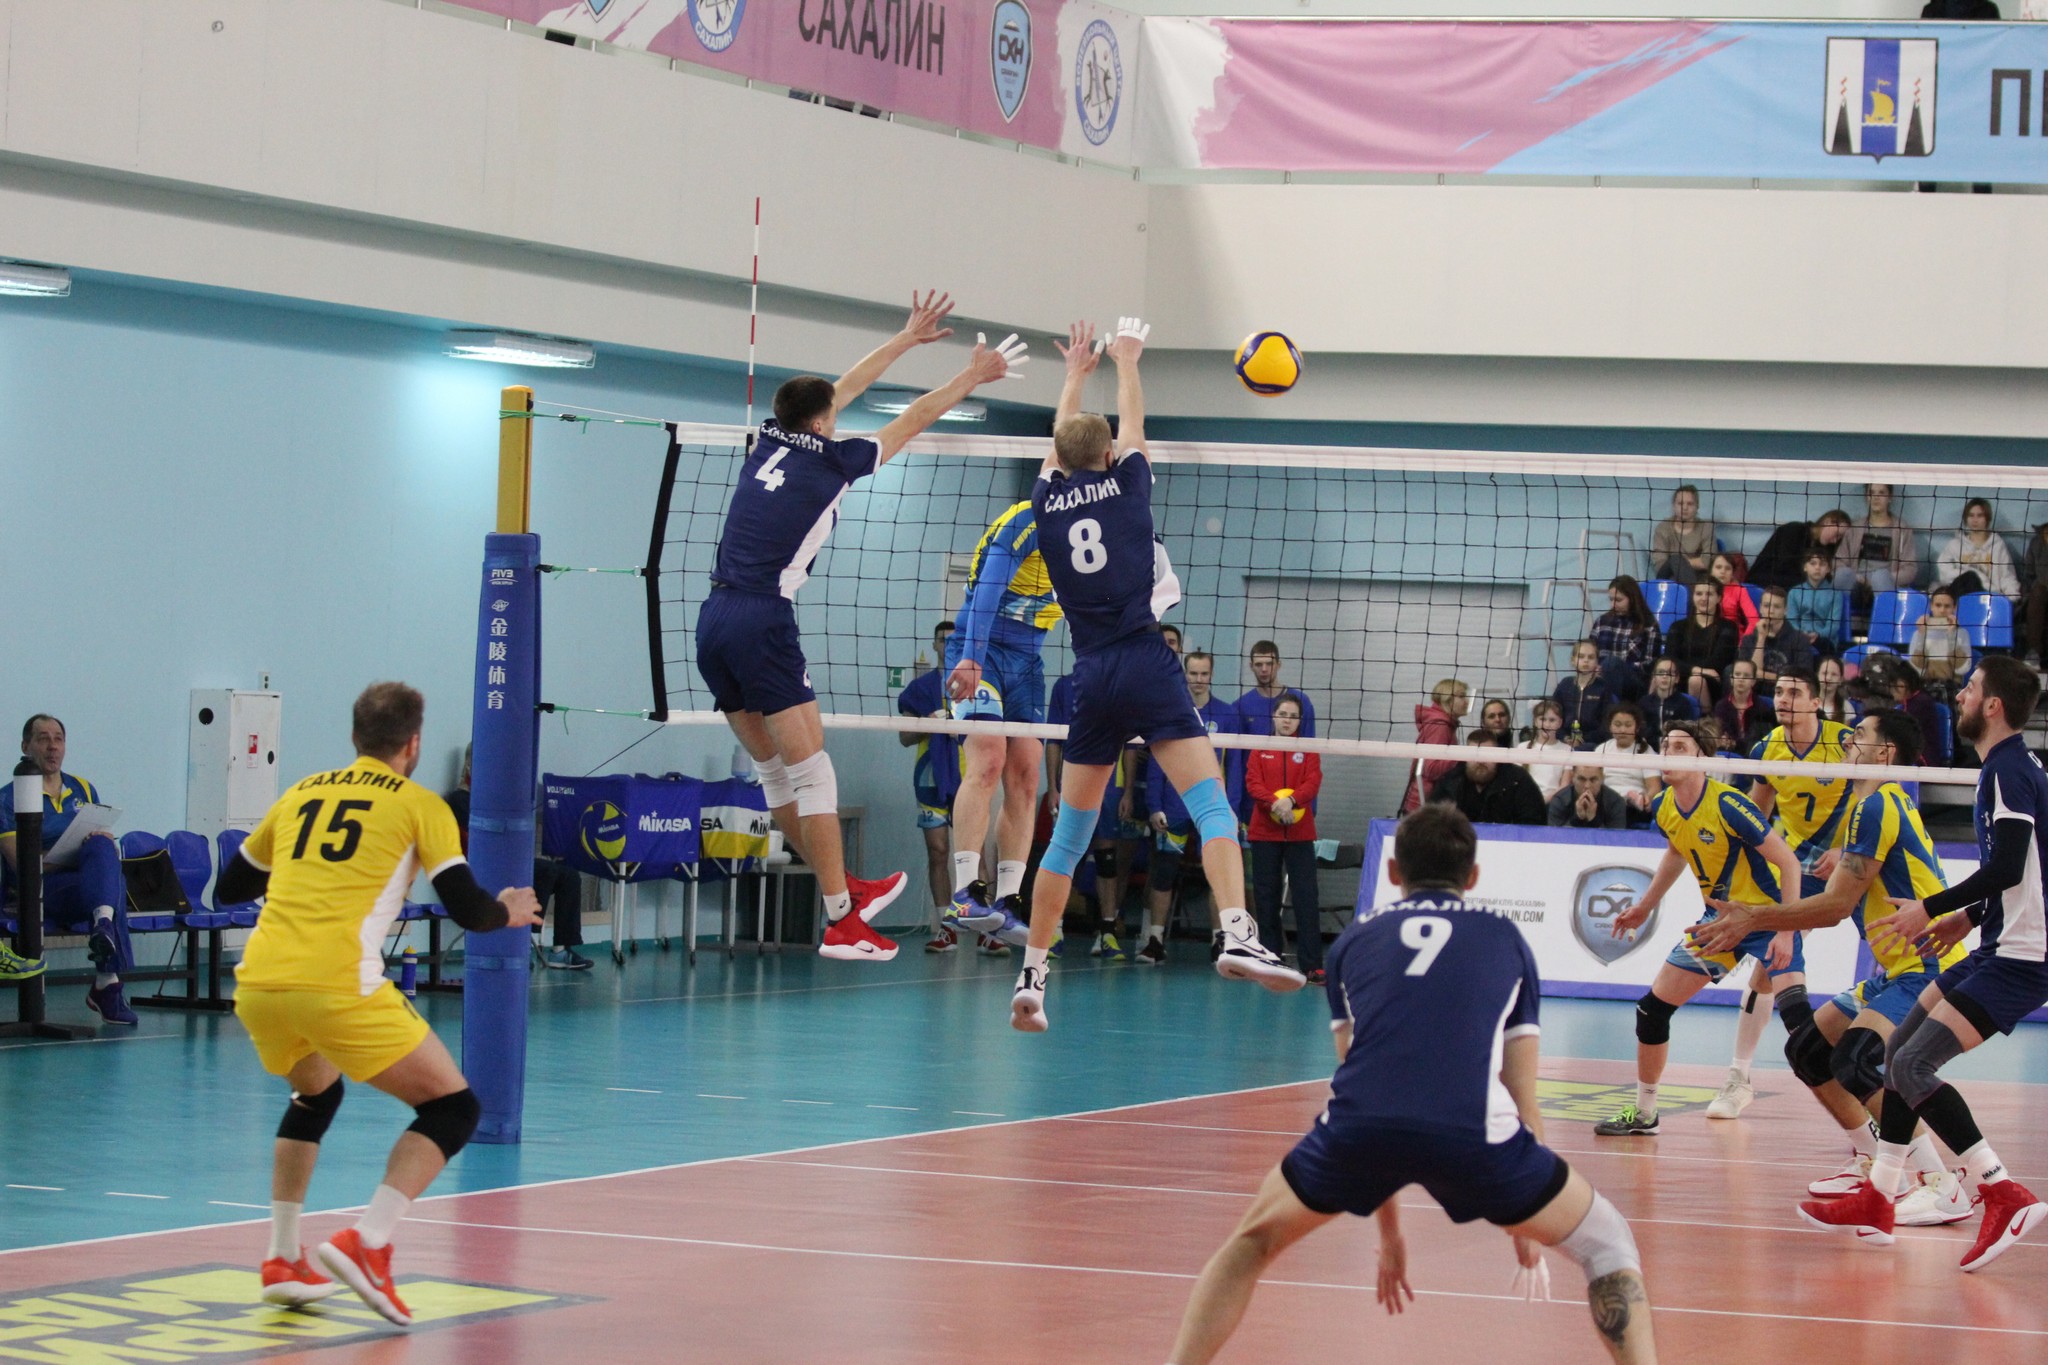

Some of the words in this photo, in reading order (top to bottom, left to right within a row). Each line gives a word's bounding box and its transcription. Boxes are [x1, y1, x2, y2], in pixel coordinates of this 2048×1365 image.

[695, 20, 733, 51] САХАЛИН
[798, 0, 945, 76] САХАЛИН
[1989, 68, 2048, 137] П
[754, 446, 791, 492] 4
[1044, 477, 1121, 514] САХАЛИН
[1068, 518, 1108, 574] 8
[491, 568, 515, 579] FIVB
[487, 617, 509, 710] 金陵体育
[297, 770, 406, 793] САХАЛИН
[639, 812, 692, 833] MIKASA
[1796, 792, 1816, 822] 7
[291, 798, 374, 862] 15
[1690, 848, 1711, 883] 1
[1401, 916, 1453, 976] 9
